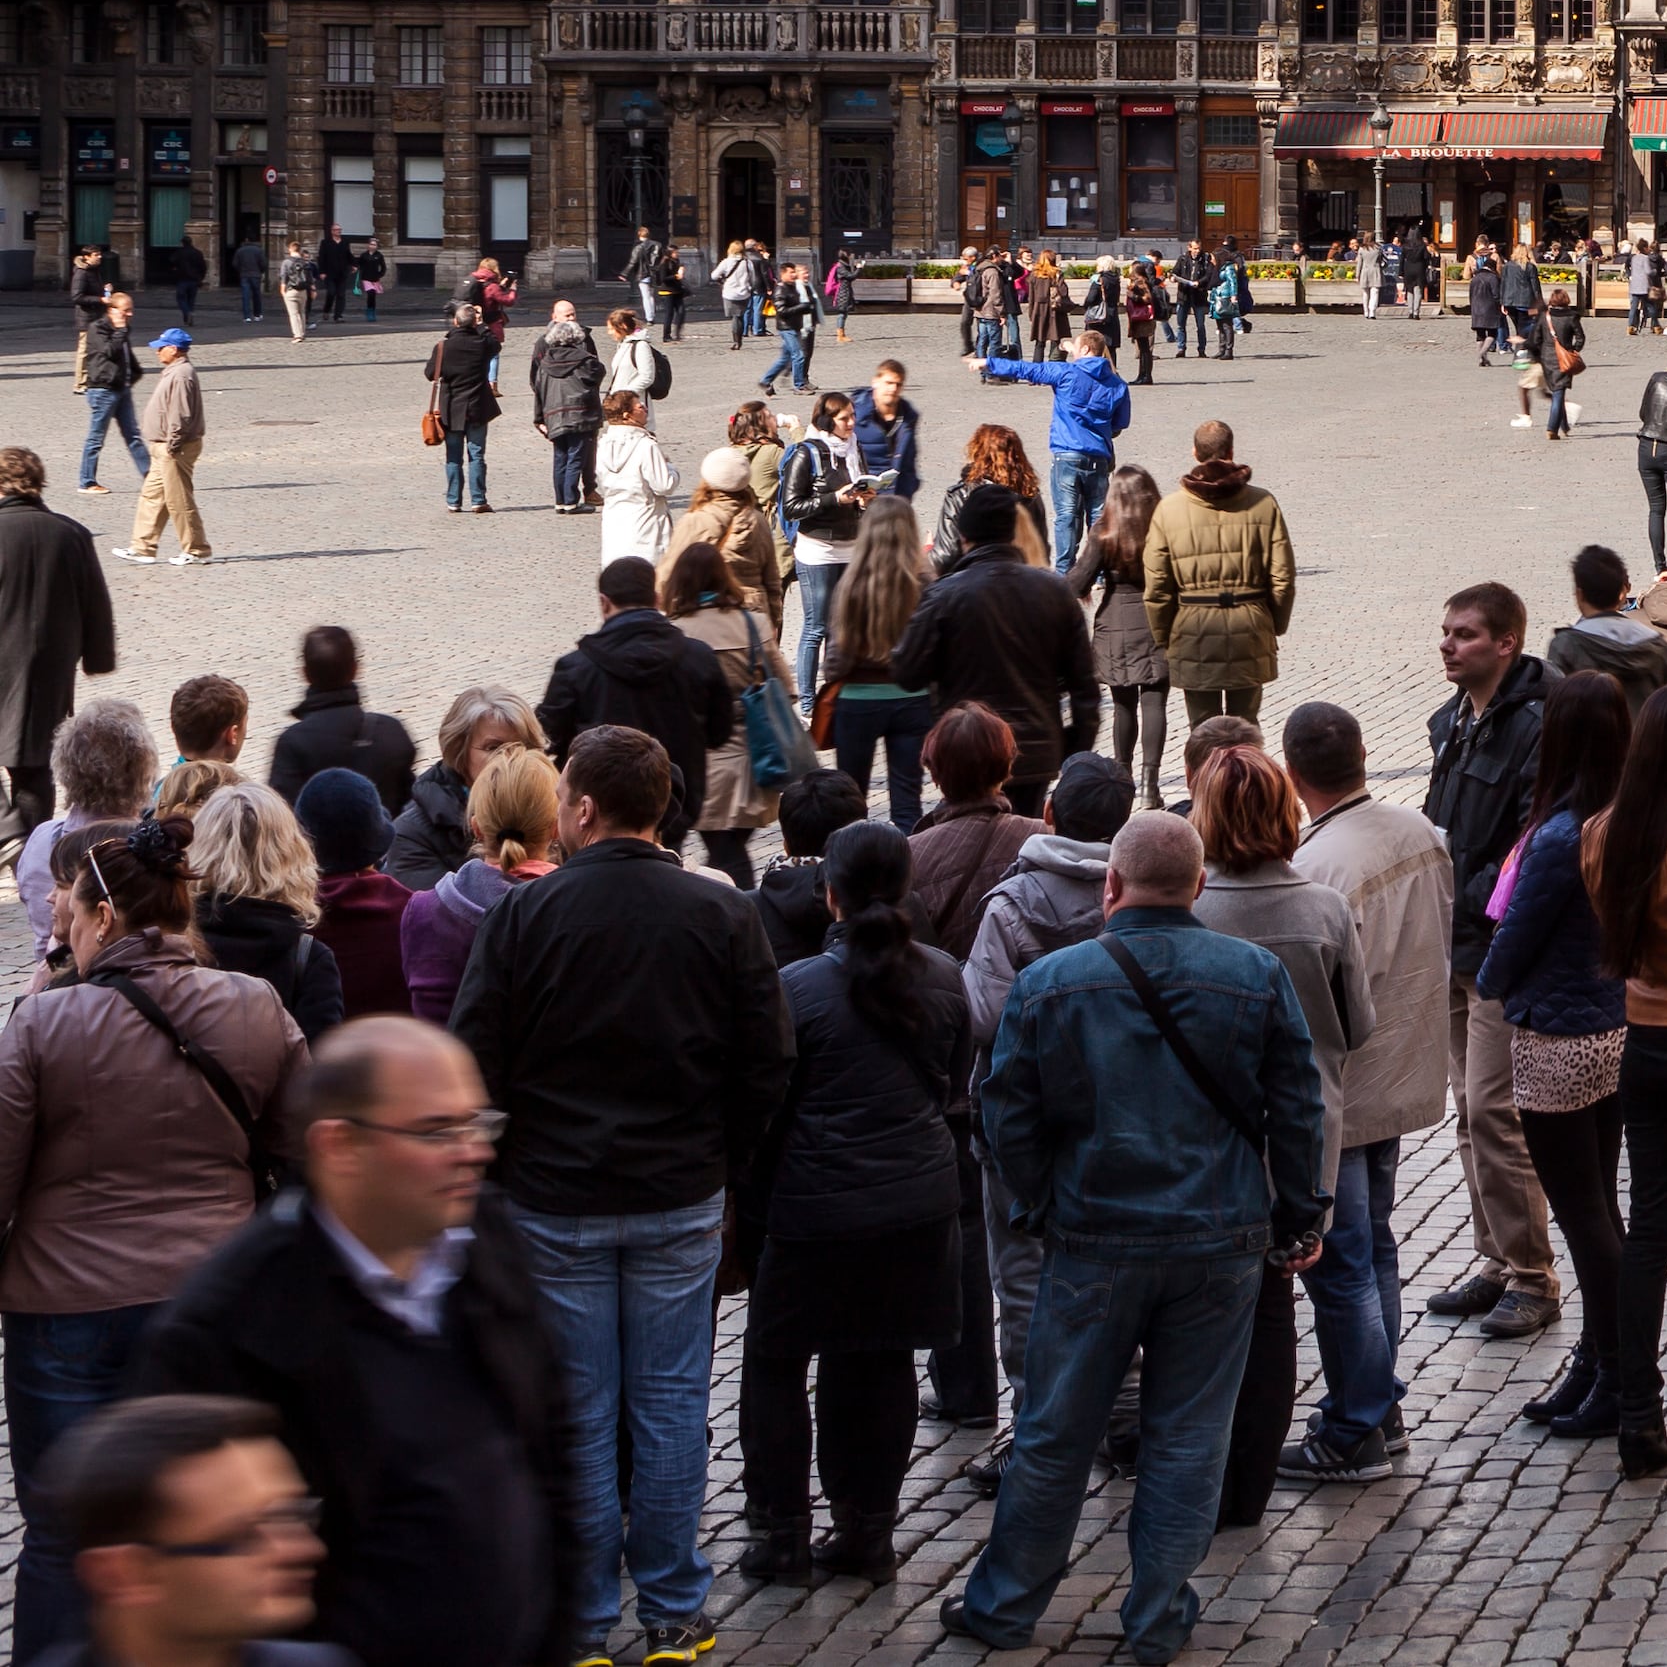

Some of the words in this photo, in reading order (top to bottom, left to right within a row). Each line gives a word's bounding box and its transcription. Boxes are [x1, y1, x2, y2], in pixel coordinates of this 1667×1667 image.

[973, 104, 1003, 113] CHOCOLAT
[1053, 105, 1083, 114] CHOCOLAT
[1133, 105, 1163, 114] CHOCOLAT
[1382, 148, 1402, 158] LA
[1410, 148, 1494, 158] BROUETTE
